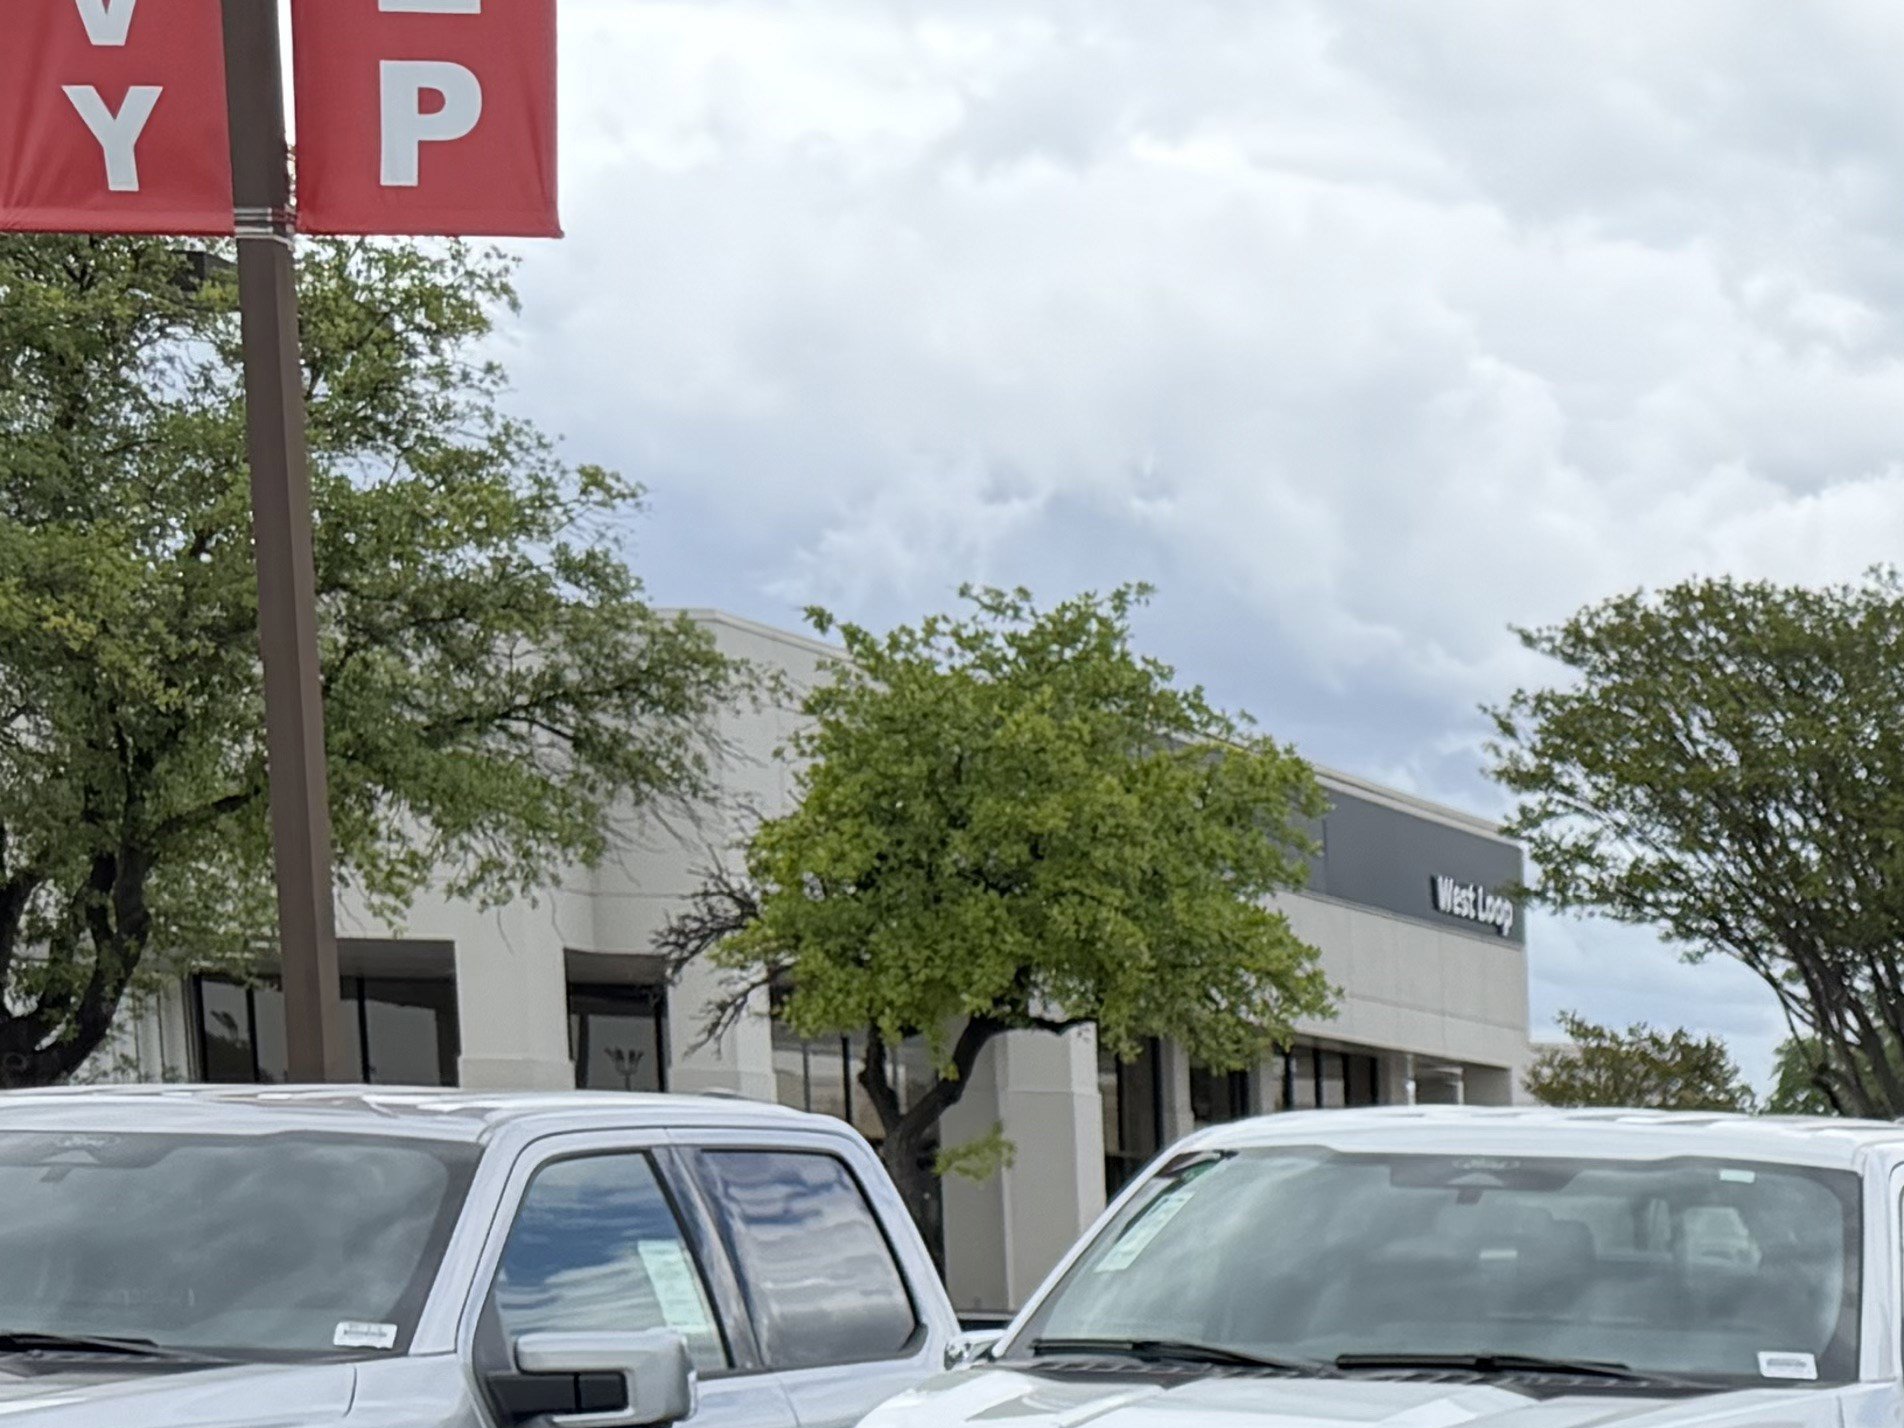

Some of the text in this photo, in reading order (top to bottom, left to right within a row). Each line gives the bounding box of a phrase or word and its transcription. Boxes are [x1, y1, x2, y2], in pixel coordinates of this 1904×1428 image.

[378, 0, 483, 187] P
[1436, 875, 1514, 937] West Loop
